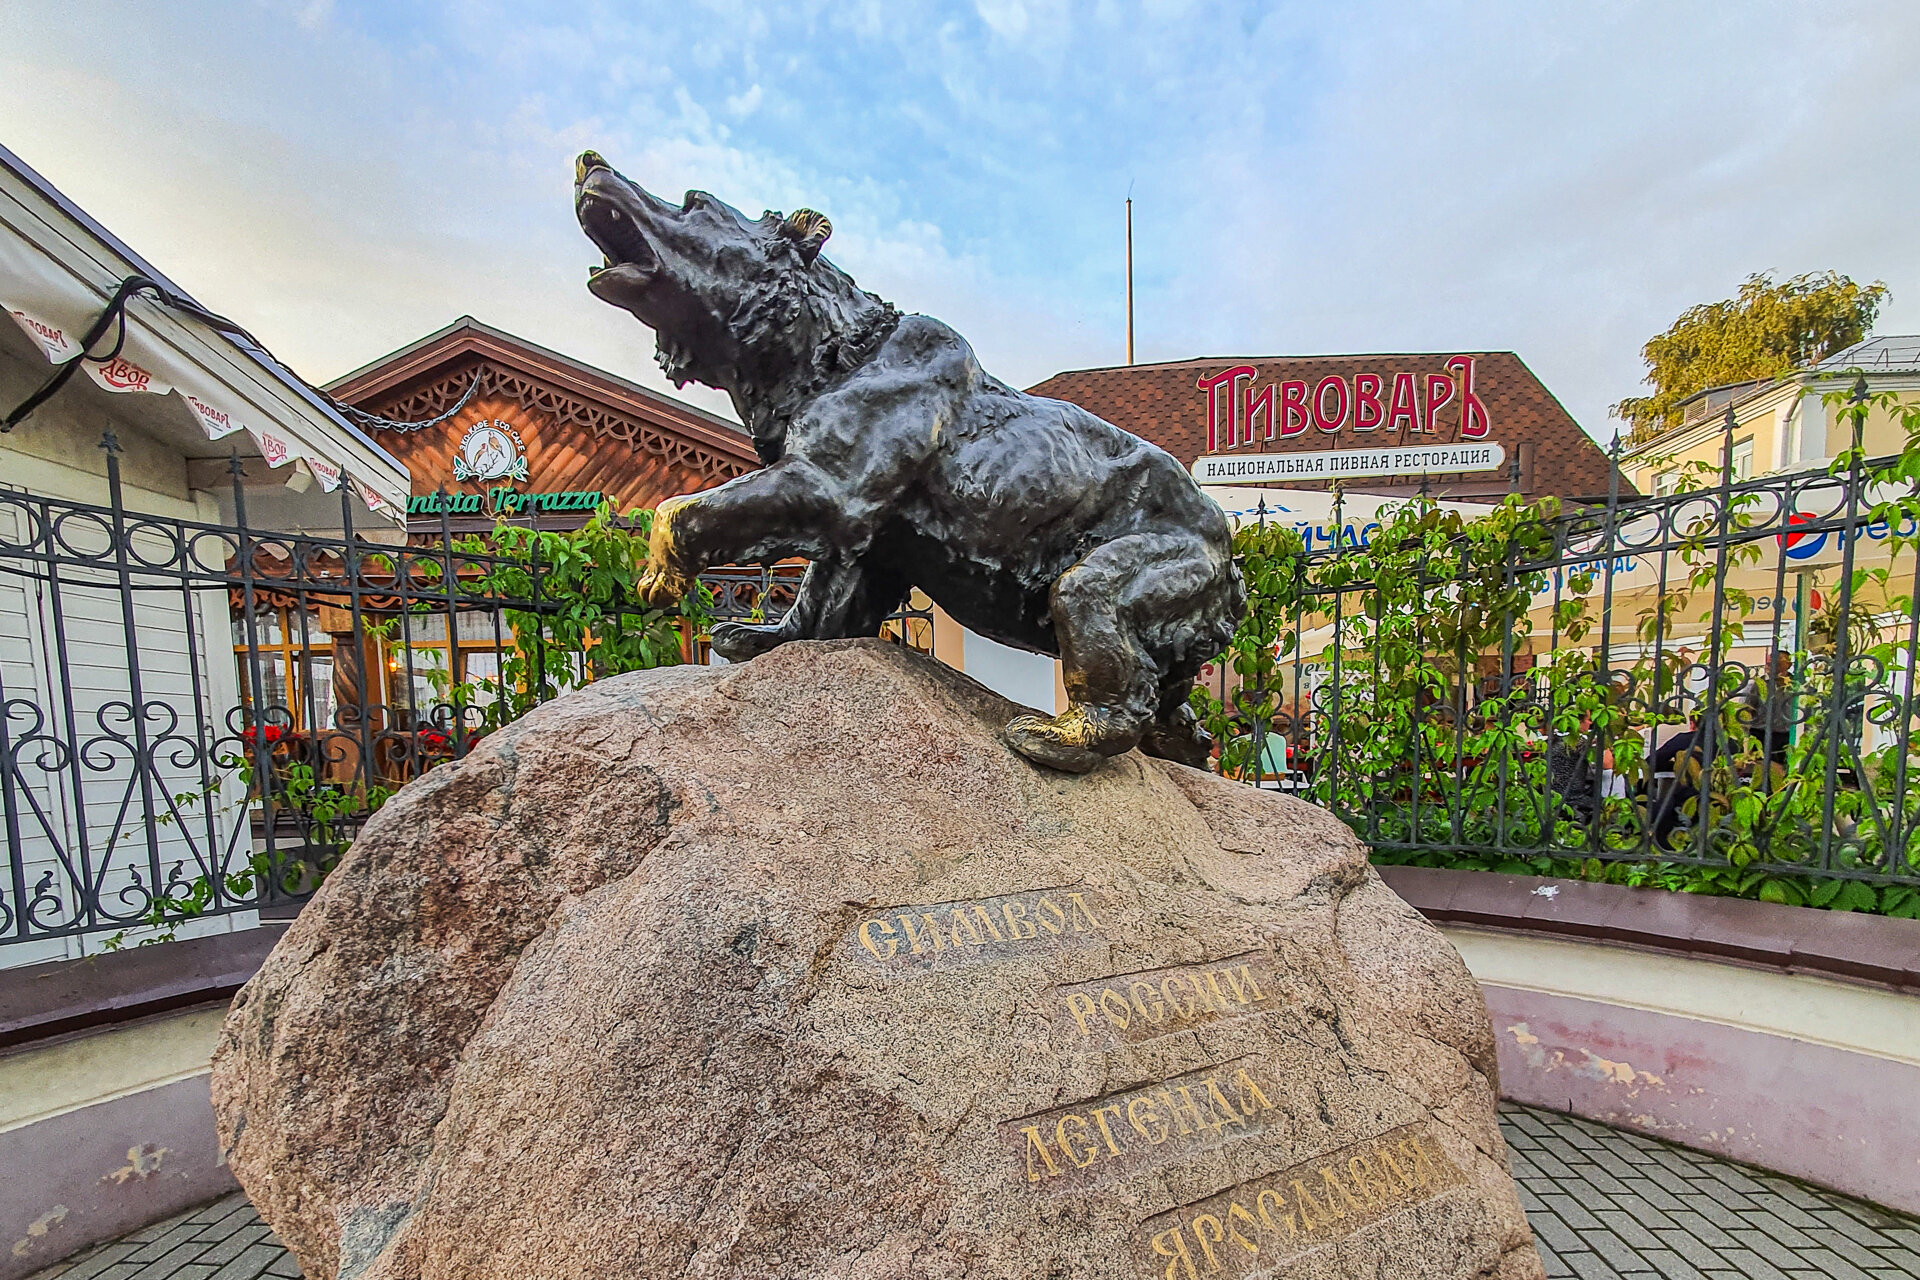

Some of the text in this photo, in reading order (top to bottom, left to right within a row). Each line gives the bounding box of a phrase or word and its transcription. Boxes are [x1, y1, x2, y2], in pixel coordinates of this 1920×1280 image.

[1197, 355, 1490, 454] ПИВОВАРЪ
[1207, 449, 1490, 477] НАЦИОНАЛЬНАЯ ПИВНАЯ РЕСТОРАЦИЯ
[490, 487, 600, 512] Terrazza
[858, 892, 1101, 961] СИМВОЛ
[1066, 964, 1266, 1035] РОССИИ
[1019, 1067, 1273, 1182] ЛЕГЕНДА
